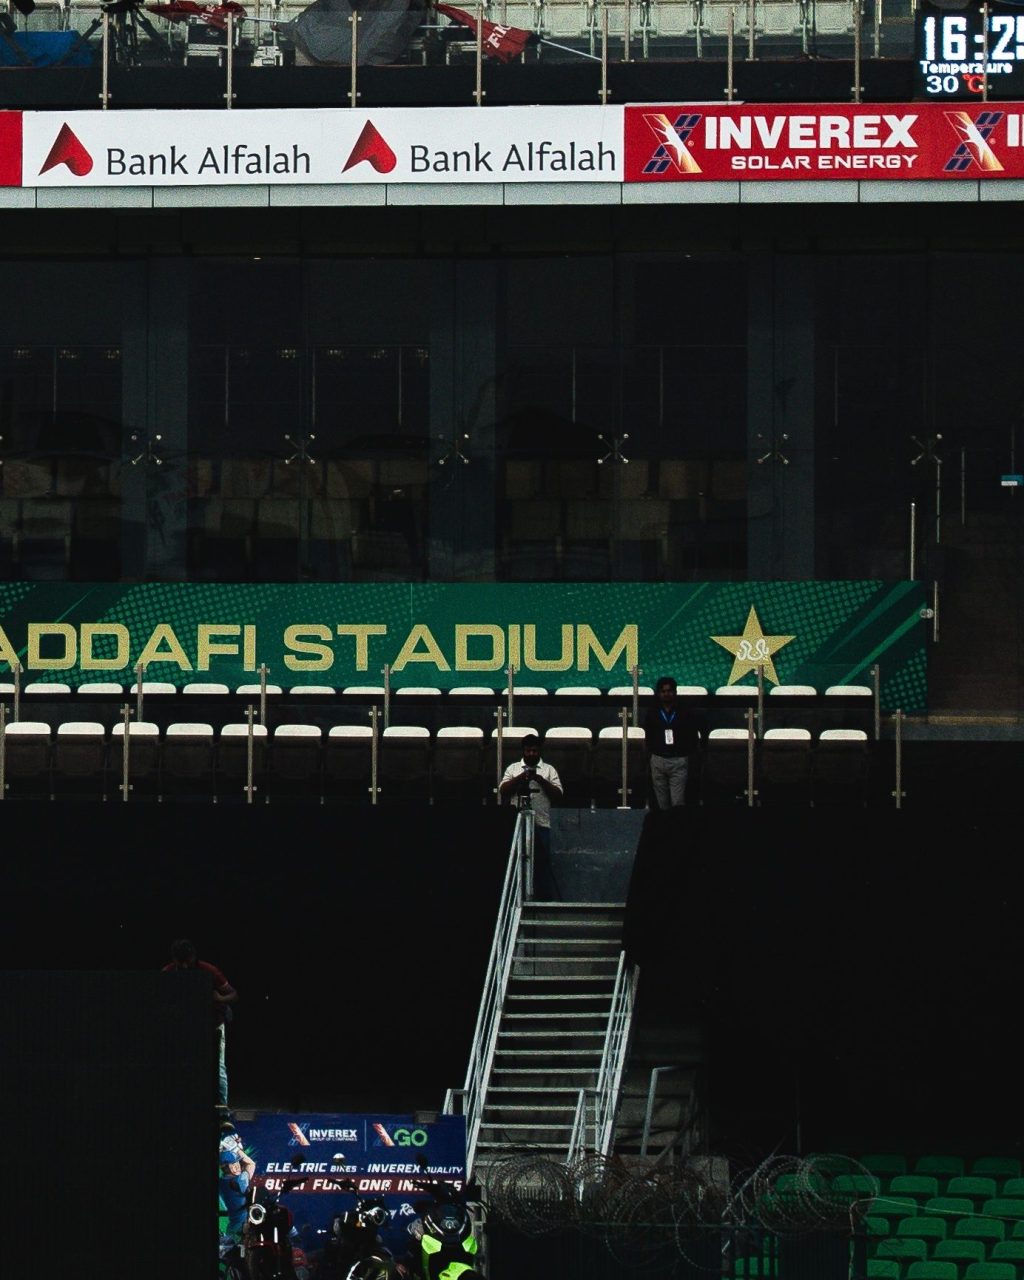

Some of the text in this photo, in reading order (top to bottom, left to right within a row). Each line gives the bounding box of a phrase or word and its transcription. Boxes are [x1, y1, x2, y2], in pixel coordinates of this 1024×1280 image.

[919, 60, 1013, 75] Temperaure
[926, 75, 959, 93] 30
[704, 114, 919, 150] INVEREX
[106, 143, 311, 176] Bank Alfalah
[410, 140, 616, 173] Bank Alfalah
[731, 154, 918, 171] SOLAR ENERGY
[282, 623, 639, 672] STADIUM
[309, 1129, 358, 1138] INVEREX
[329, 1165, 357, 1173] BIKES
[367, 1163, 421, 1173] INVEREX
